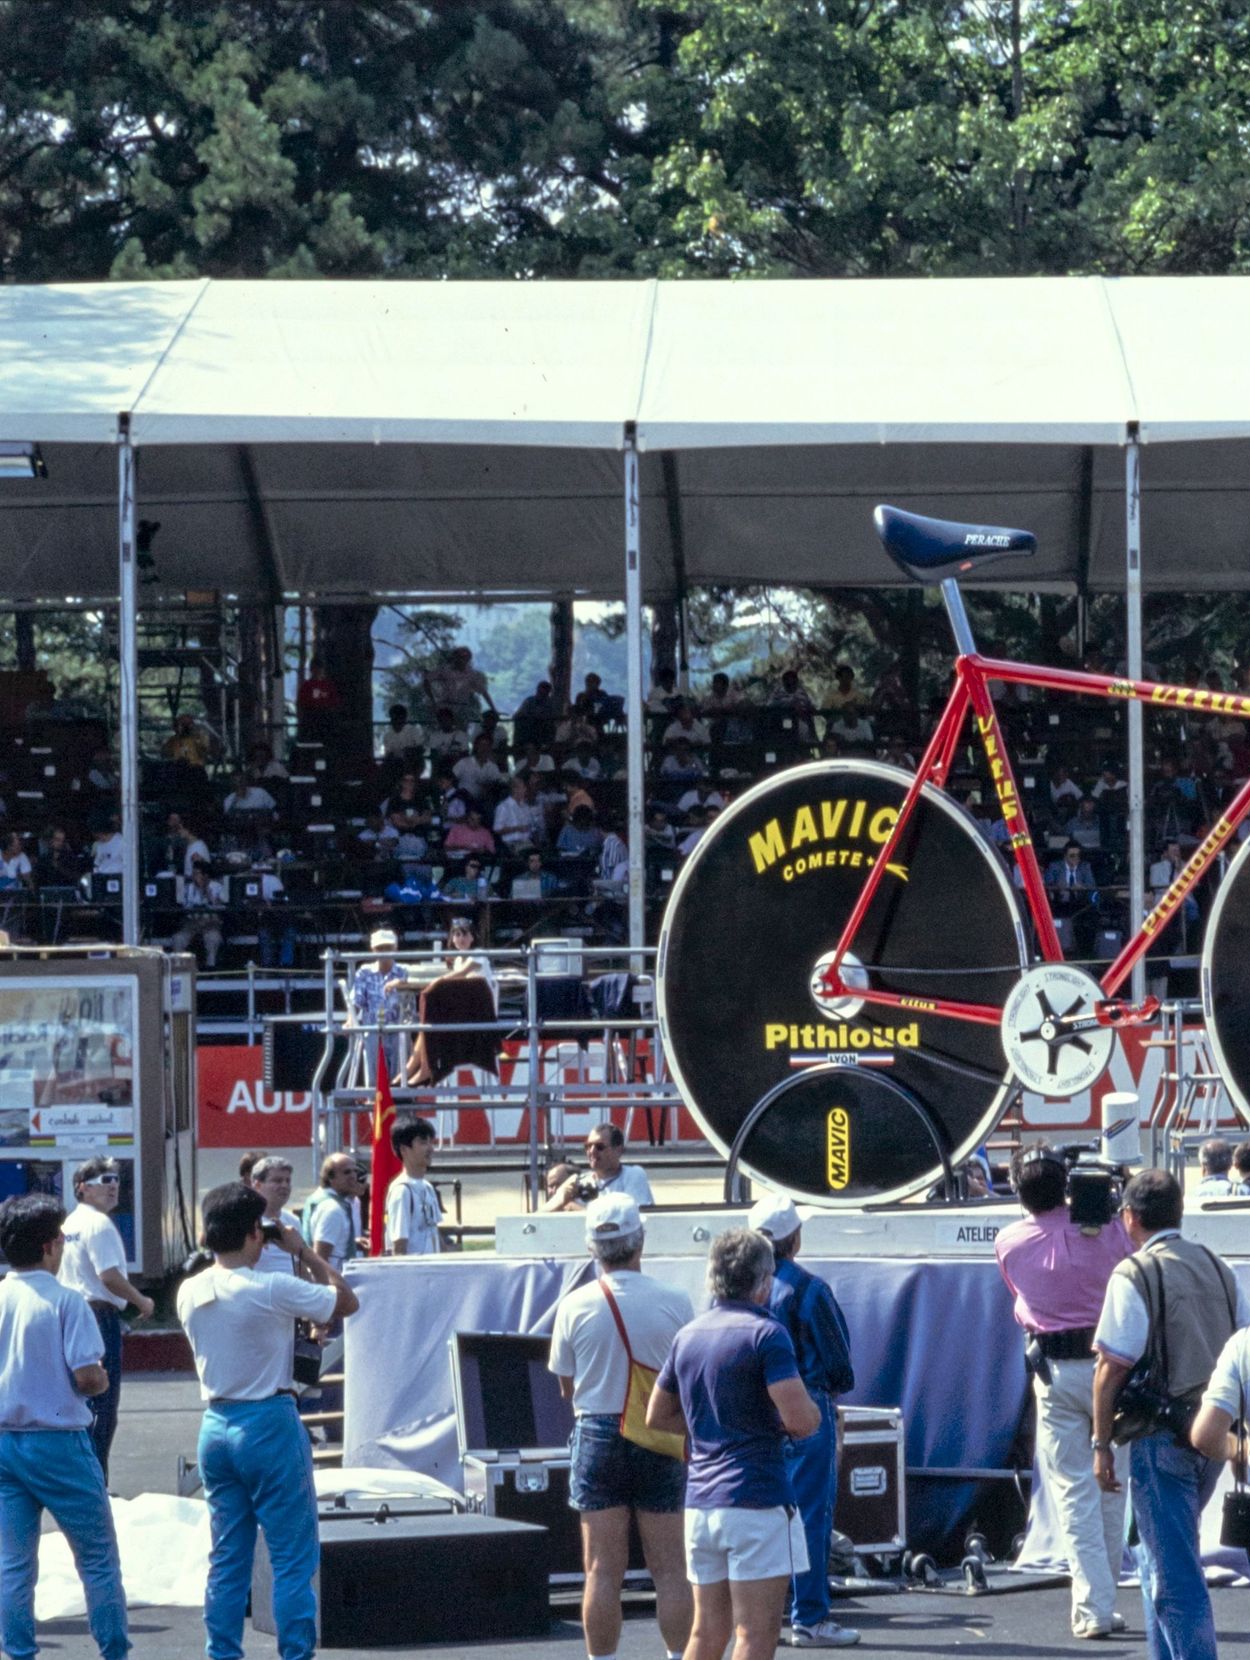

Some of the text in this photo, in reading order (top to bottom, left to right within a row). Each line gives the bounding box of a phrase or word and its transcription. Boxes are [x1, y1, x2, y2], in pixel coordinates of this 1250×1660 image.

[748, 800, 901, 874] MAVIC
[783, 851, 862, 882] COMETE
[765, 1023, 919, 1049] Pithioud
[829, 1055, 858, 1064] LYON
[831, 1111, 846, 1184] MAVIC
